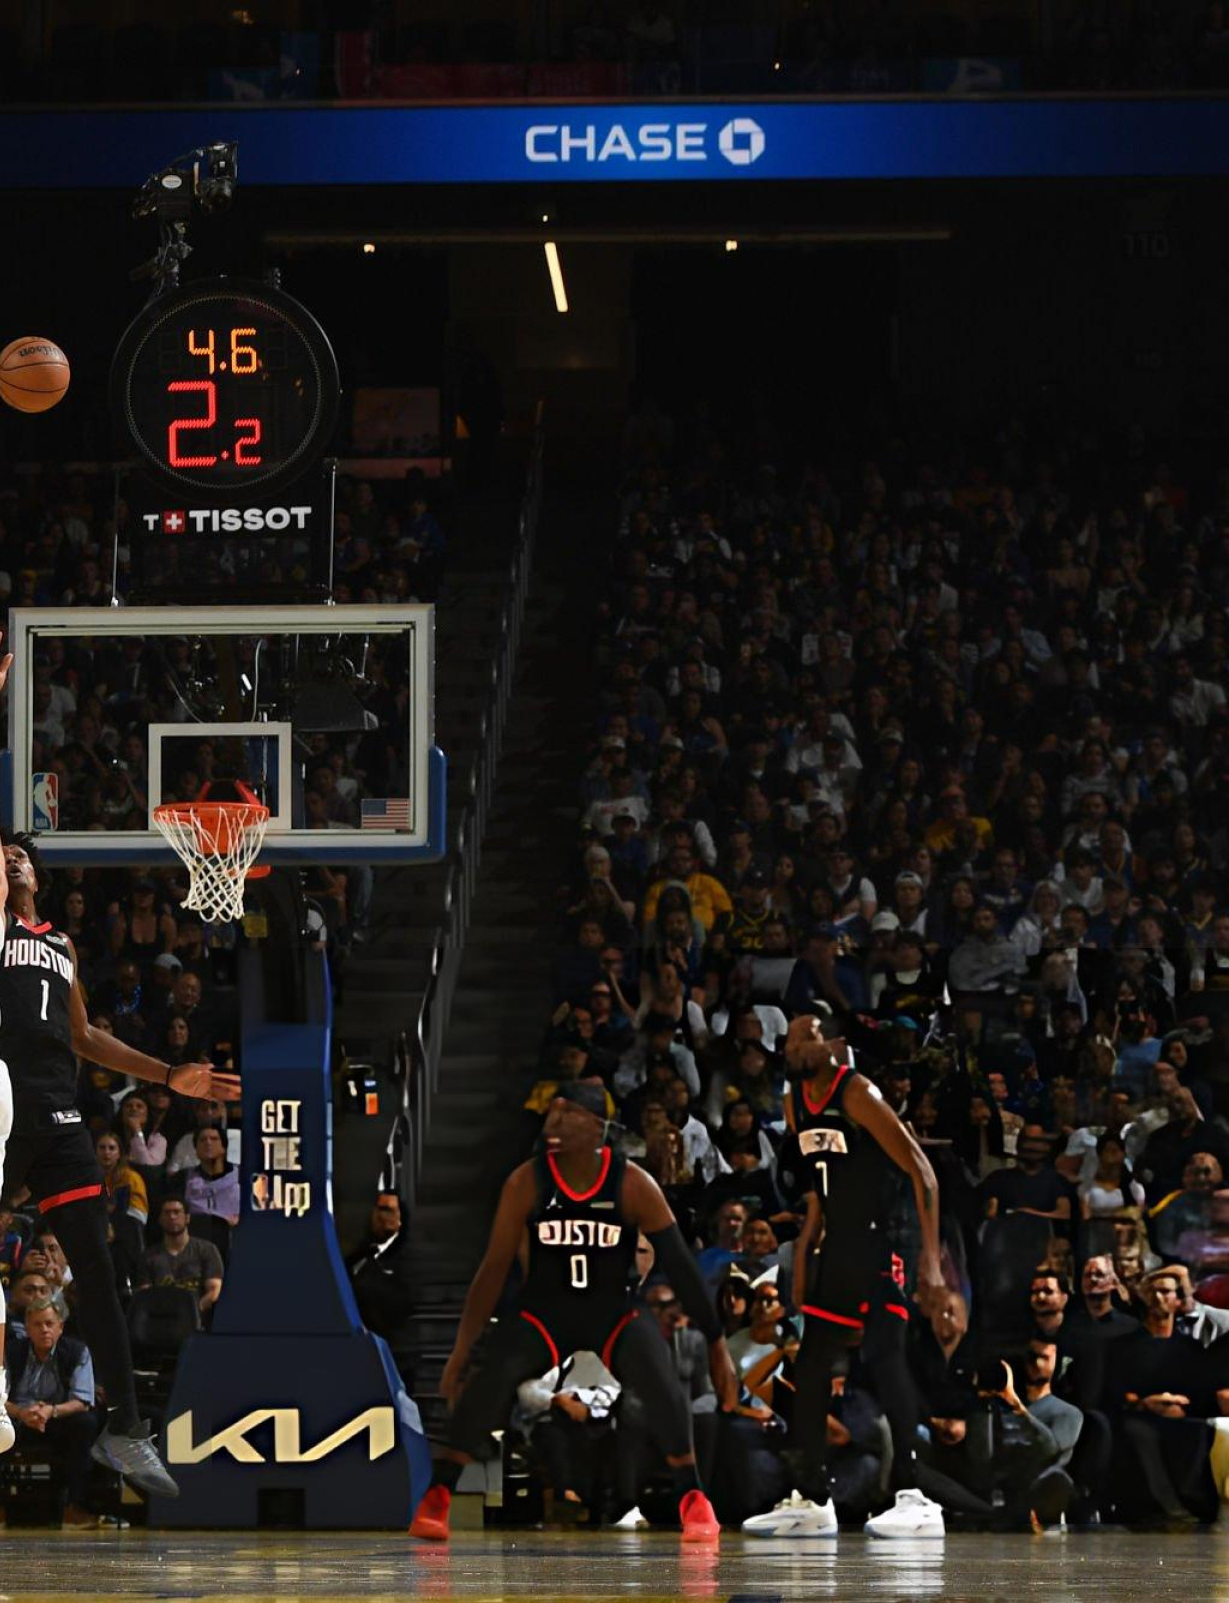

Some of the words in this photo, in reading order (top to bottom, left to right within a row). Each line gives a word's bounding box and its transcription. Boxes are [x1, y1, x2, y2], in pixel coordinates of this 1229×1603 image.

[525, 124, 708, 162] CHASE
[188, 328, 258, 375] 4.6
[168, 380, 262, 467] 2.2
[4, 938, 74, 988] HOUSTON
[40, 979, 50, 1021] 1
[261, 1099, 302, 1133] GET
[570, 1254, 587, 1288] 0
[167, 1406, 395, 1464] KIA
